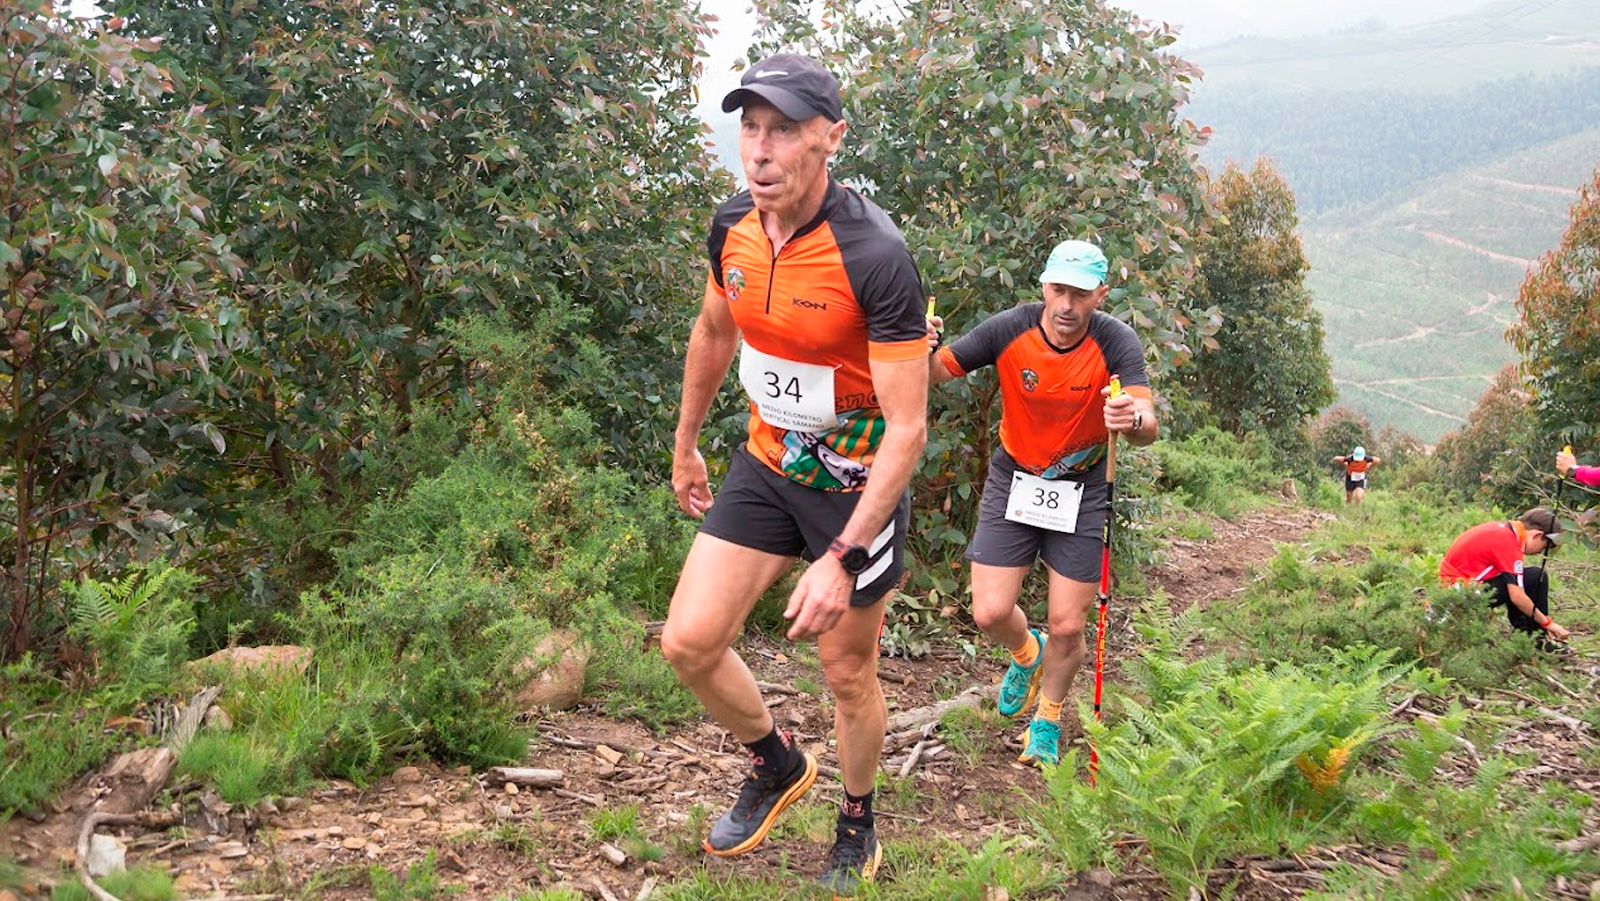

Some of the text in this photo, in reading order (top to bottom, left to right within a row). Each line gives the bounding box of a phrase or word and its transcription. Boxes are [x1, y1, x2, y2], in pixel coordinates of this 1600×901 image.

[764, 371, 803, 403] 34
[761, 403, 823, 423] MEDIO KILOMETRO
[1032, 487, 1060, 509] 38
